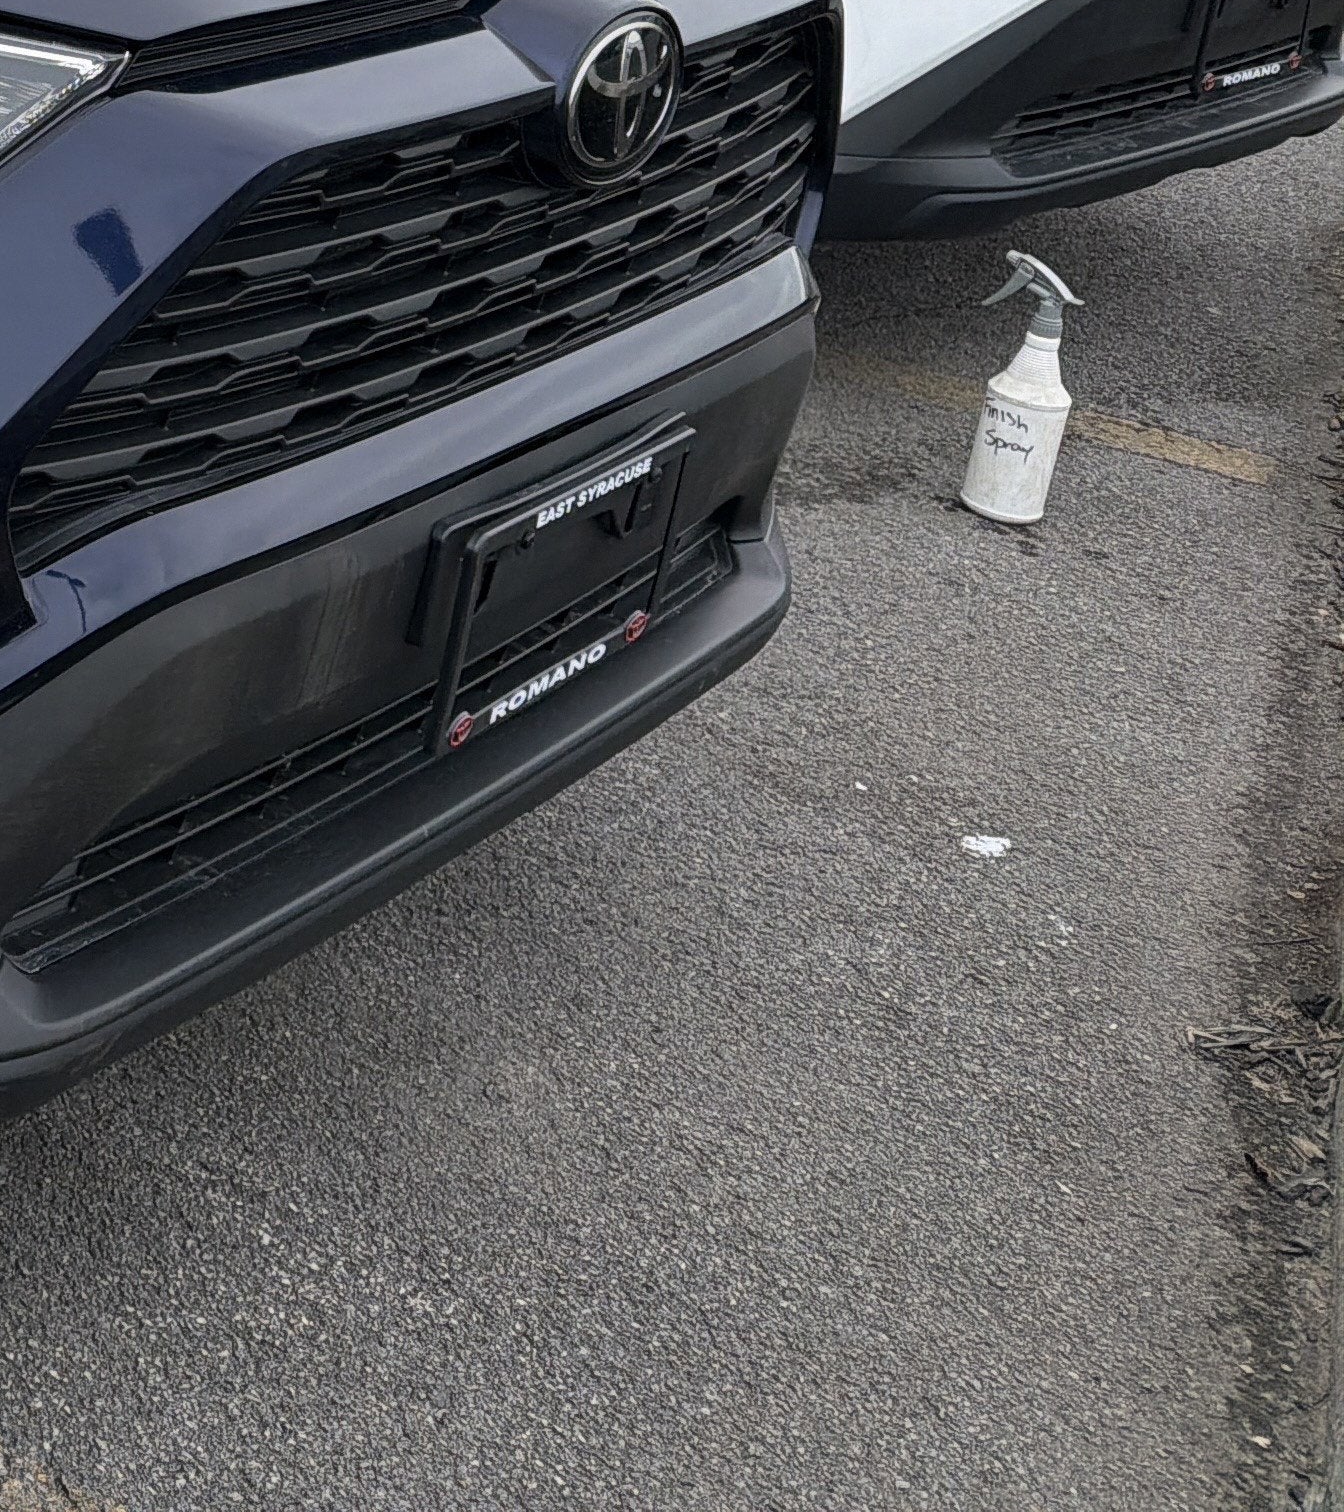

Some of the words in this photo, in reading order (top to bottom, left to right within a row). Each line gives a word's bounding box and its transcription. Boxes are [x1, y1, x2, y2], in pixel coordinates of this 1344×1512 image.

[1223, 64, 1280, 86] ROMANO
[984, 428, 1034, 464] Spray
[535, 494, 576, 529] EAST
[576, 456, 653, 508] SYRACUSE
[488, 643, 607, 725] ROMANO
